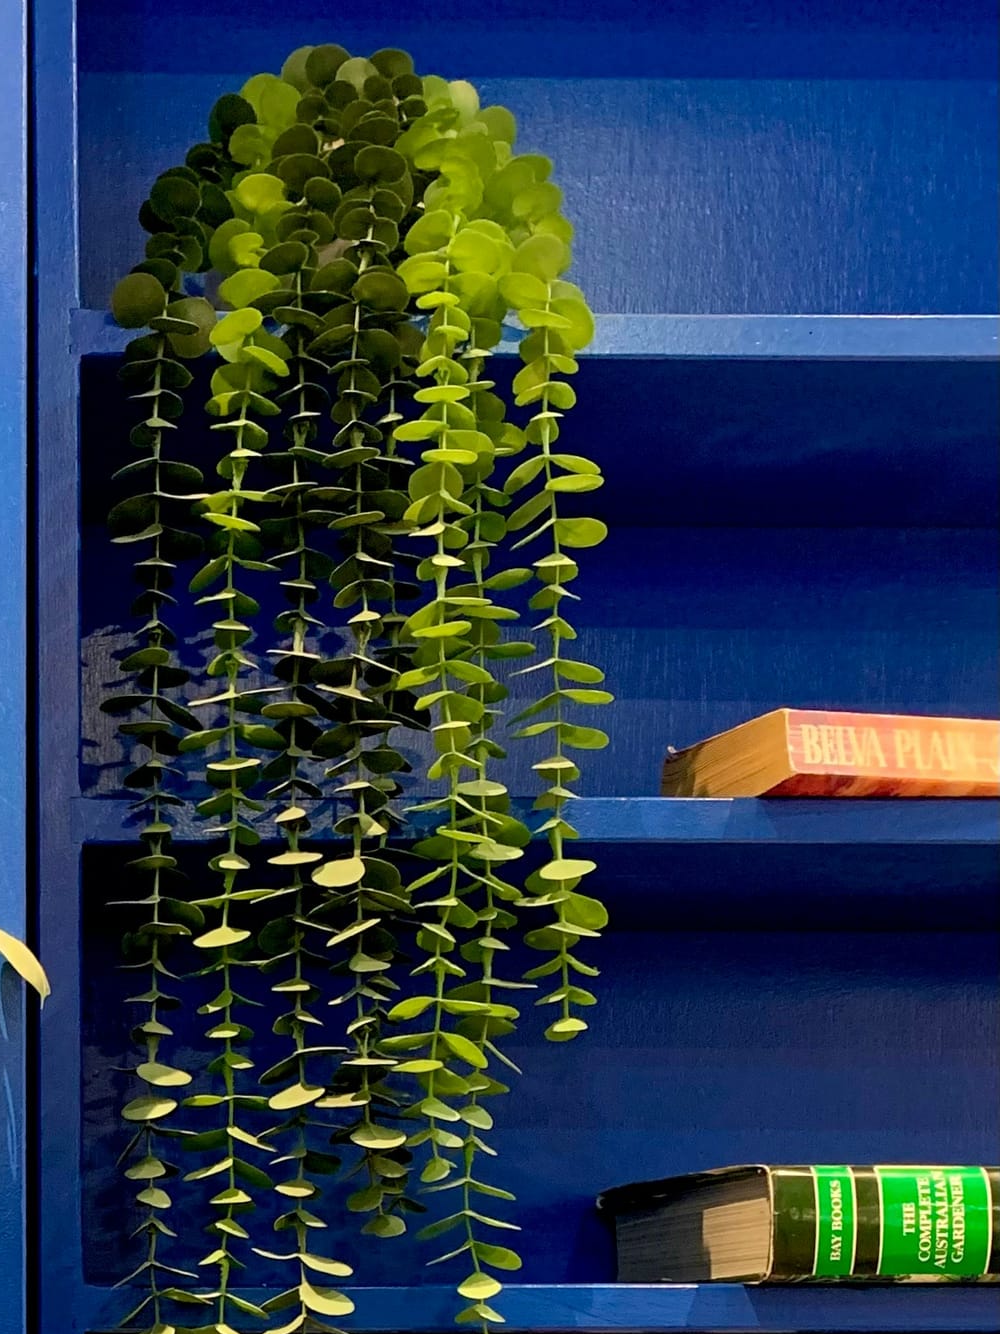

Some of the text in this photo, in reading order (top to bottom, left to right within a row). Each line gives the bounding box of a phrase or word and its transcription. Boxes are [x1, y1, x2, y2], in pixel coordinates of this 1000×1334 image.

[800, 724, 976, 772] BELVA PLAIN
[830, 1180, 843, 1261] BAY BOOKS
[902, 1202, 915, 1236] THE
[917, 1176, 932, 1262] COMPLETE
[949, 1174, 965, 1263] GARDENER
